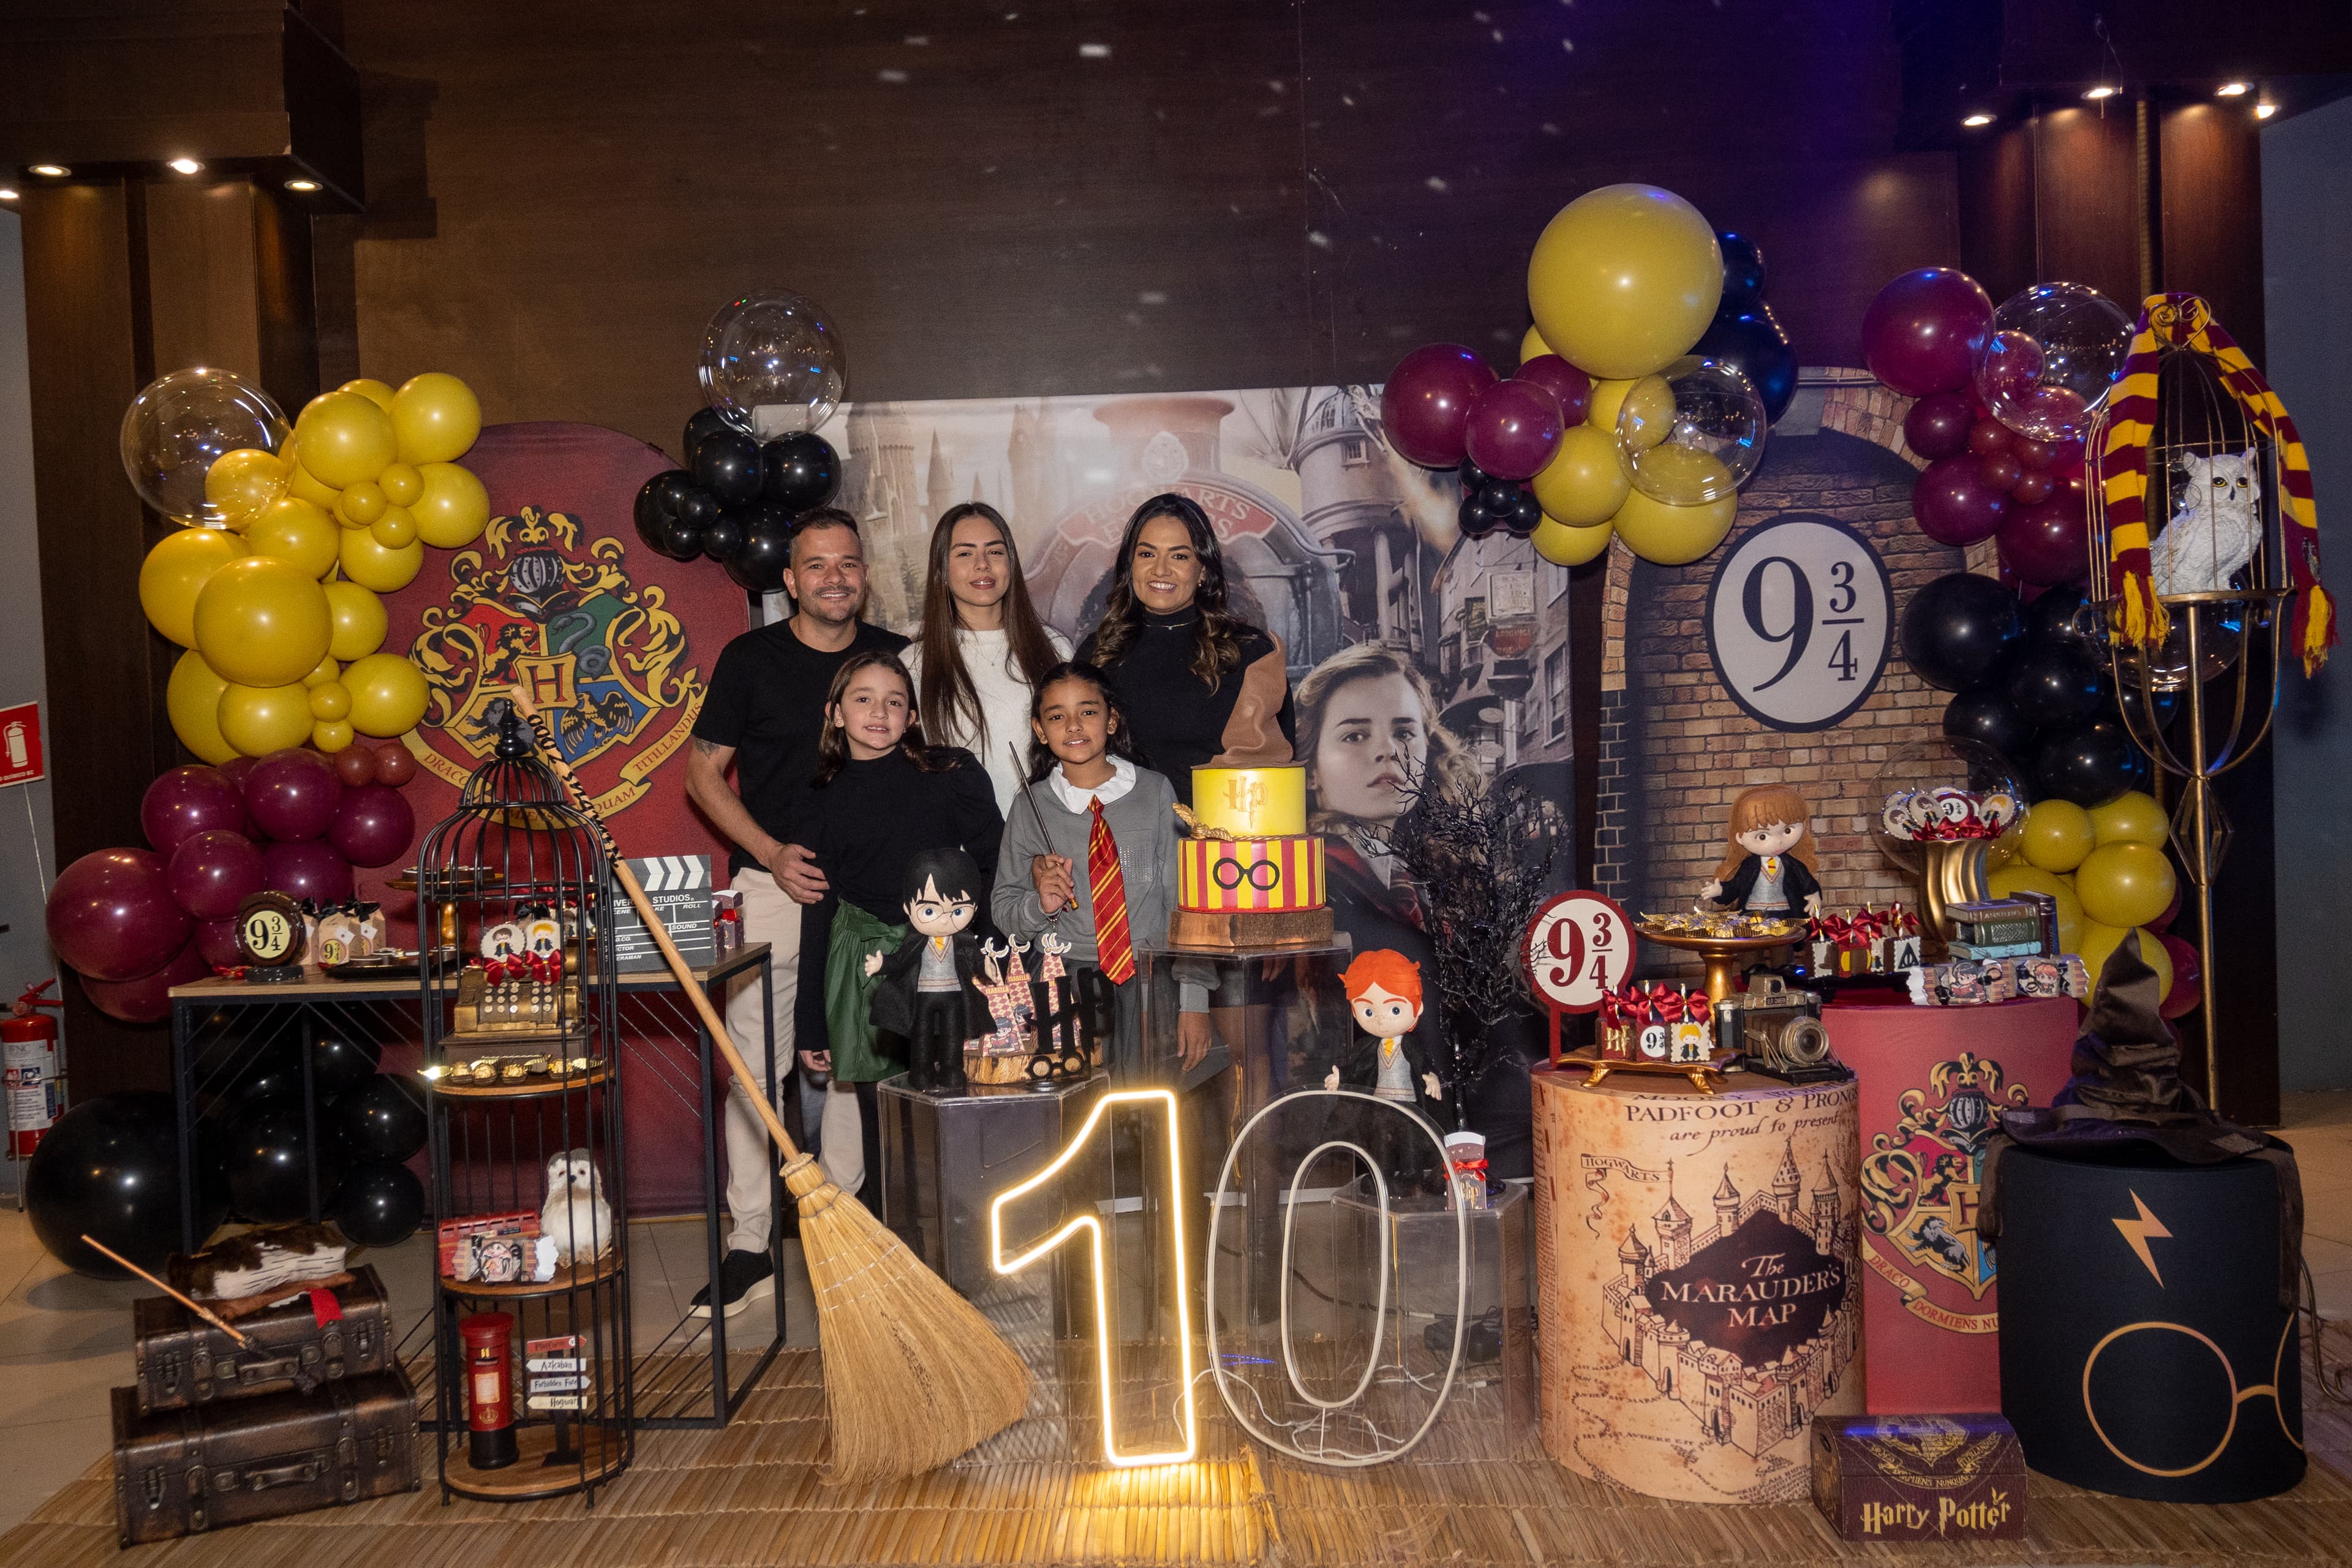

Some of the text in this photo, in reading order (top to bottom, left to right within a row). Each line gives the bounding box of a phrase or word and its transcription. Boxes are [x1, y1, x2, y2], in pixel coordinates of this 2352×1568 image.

[527, 714, 565, 764] 2000
[633, 703, 702, 772] TITILLANDUS
[594, 787, 636, 814] QUAM
[985, 986, 1009, 995] ISABELLA
[1008, 974, 1030, 982] ISABELLA
[1624, 1101, 1760, 1121] PADFOOT
[1775, 1097, 1794, 1113] &
[1670, 1110, 1839, 1157] are proud to present
[1586, 1158, 1660, 1182] HOGWARTS
[990, 1088, 1466, 1467] 10
[1741, 1253, 1785, 1278] The
[1869, 1255, 1910, 1288] DRACO
[1660, 1264, 1841, 1303] MARAUDER'S
[1727, 1303, 1796, 1328] MAP
[1912, 1299, 1978, 1330] DORMIENS
[541, 1360, 572, 1371] Azkaban
[535, 1380, 562, 1390] Forbidden
[1860, 1495, 2011, 1538] Harry Potter
